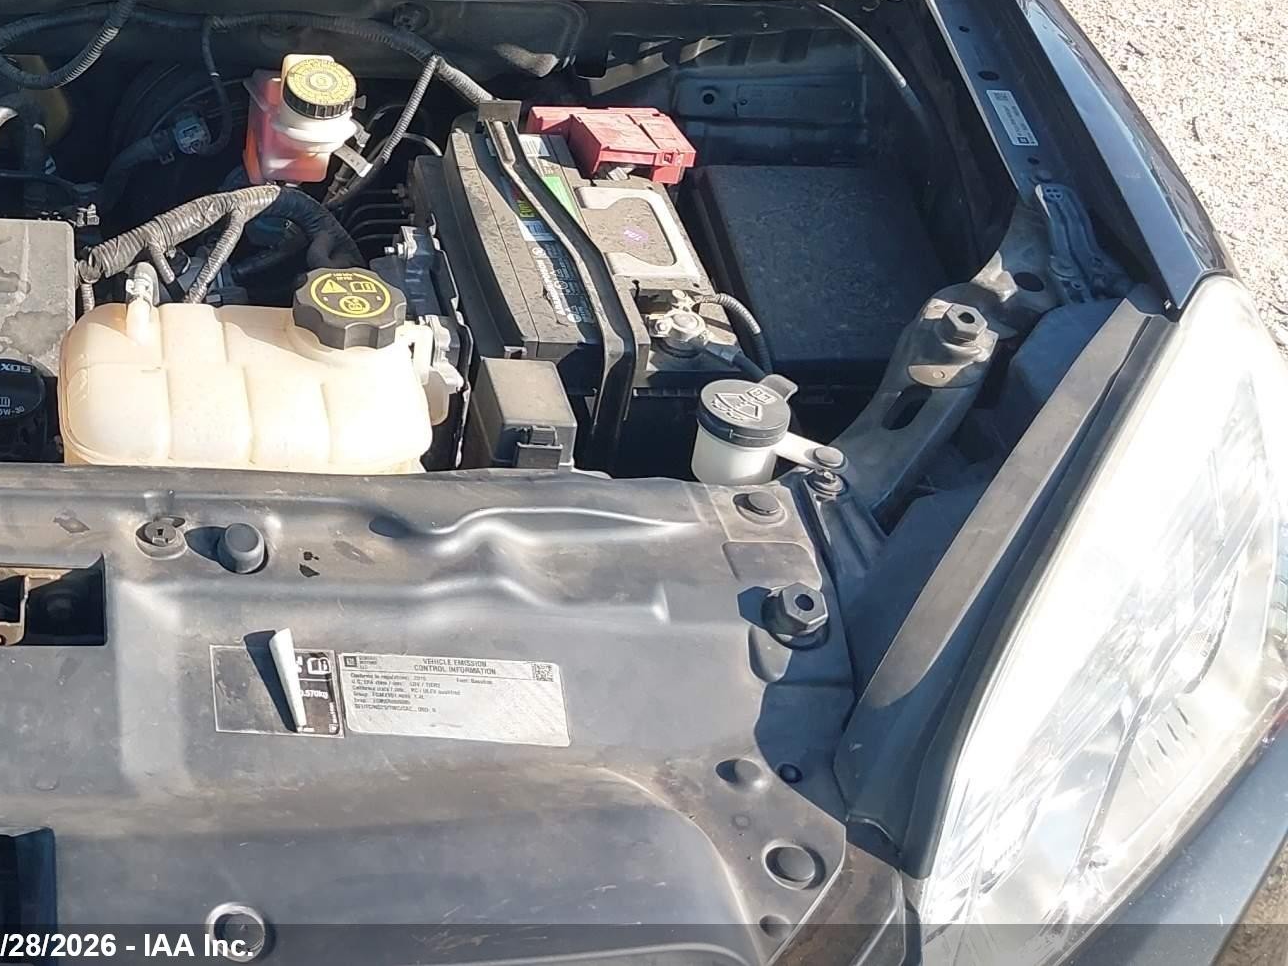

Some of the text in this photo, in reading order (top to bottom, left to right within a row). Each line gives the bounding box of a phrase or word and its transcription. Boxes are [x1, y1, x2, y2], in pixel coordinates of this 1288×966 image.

[423, 658, 487, 667] VEHICLE EMISSION
[448, 666, 496, 675] INFORMATION
